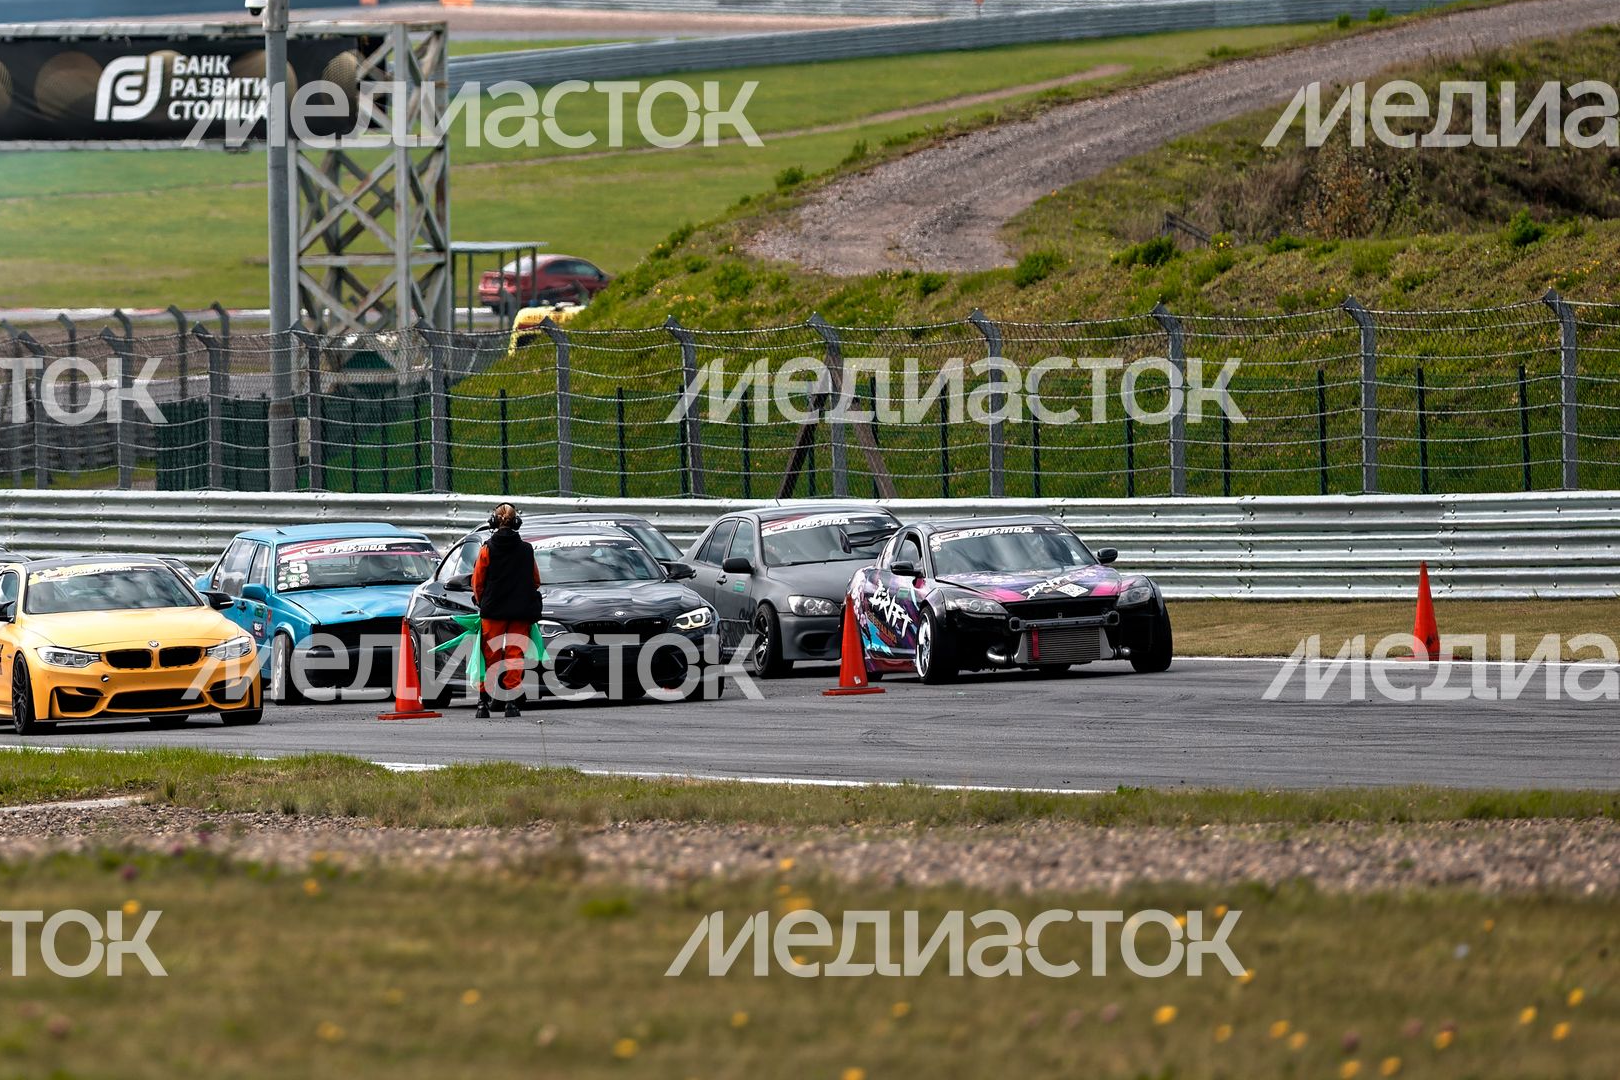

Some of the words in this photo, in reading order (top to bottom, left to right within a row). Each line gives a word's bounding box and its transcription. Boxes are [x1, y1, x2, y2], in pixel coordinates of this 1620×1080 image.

[172, 54, 231, 76] БАНК
[170, 77, 270, 100] РАЗВИТИ
[167, 99, 269, 123] СТОЛИЦА
